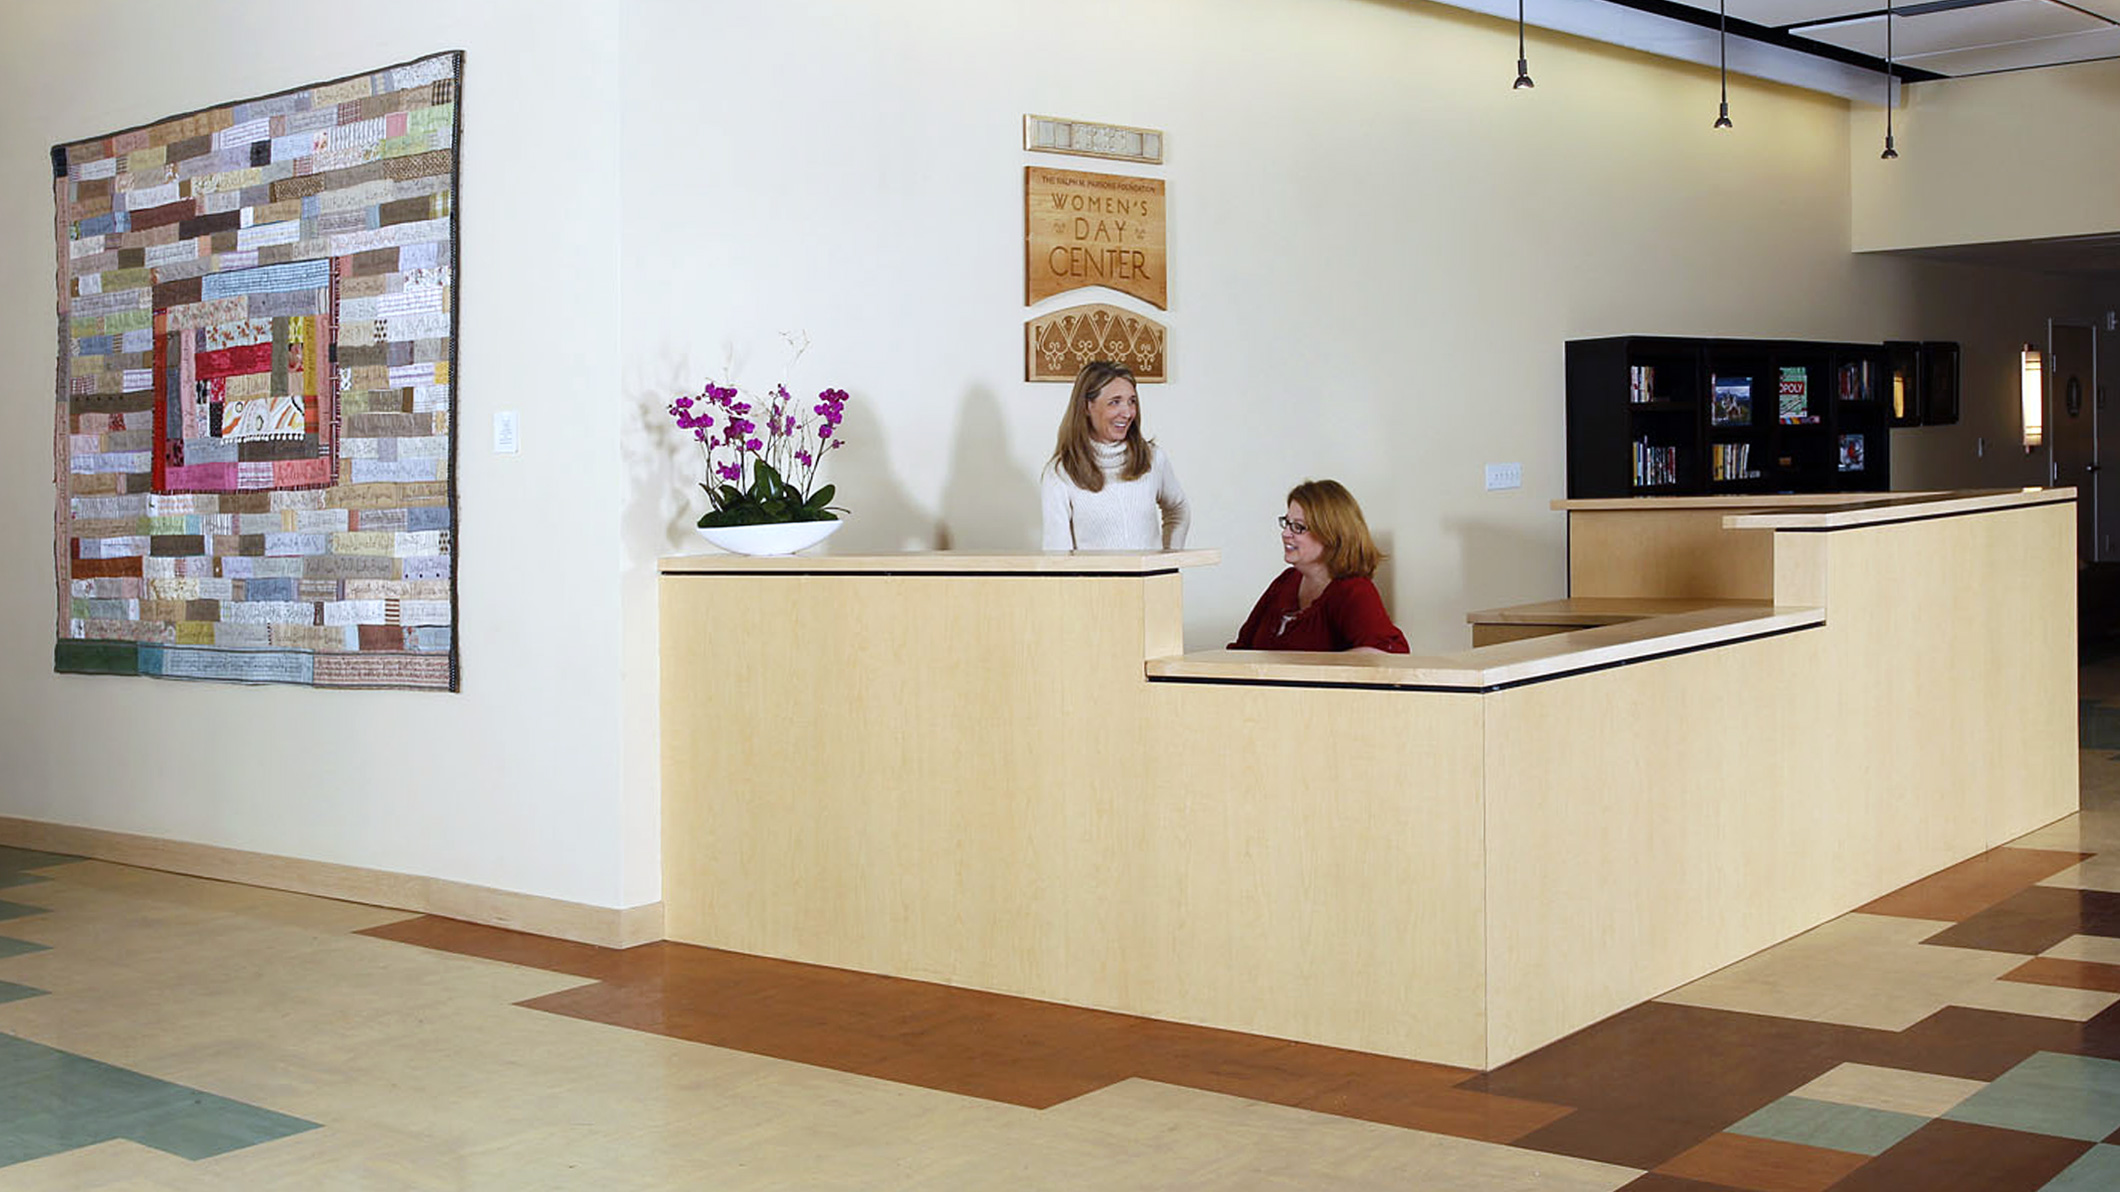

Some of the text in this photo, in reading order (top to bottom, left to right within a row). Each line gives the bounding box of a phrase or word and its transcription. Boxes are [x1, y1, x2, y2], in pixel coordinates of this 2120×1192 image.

[1042, 175, 1056, 185] THE
[1117, 183, 1155, 193] FOUNDATION
[1051, 192, 1148, 216] WOMEN'S
[1075, 217, 1127, 243] DAY
[1048, 246, 1151, 280] CENTER
